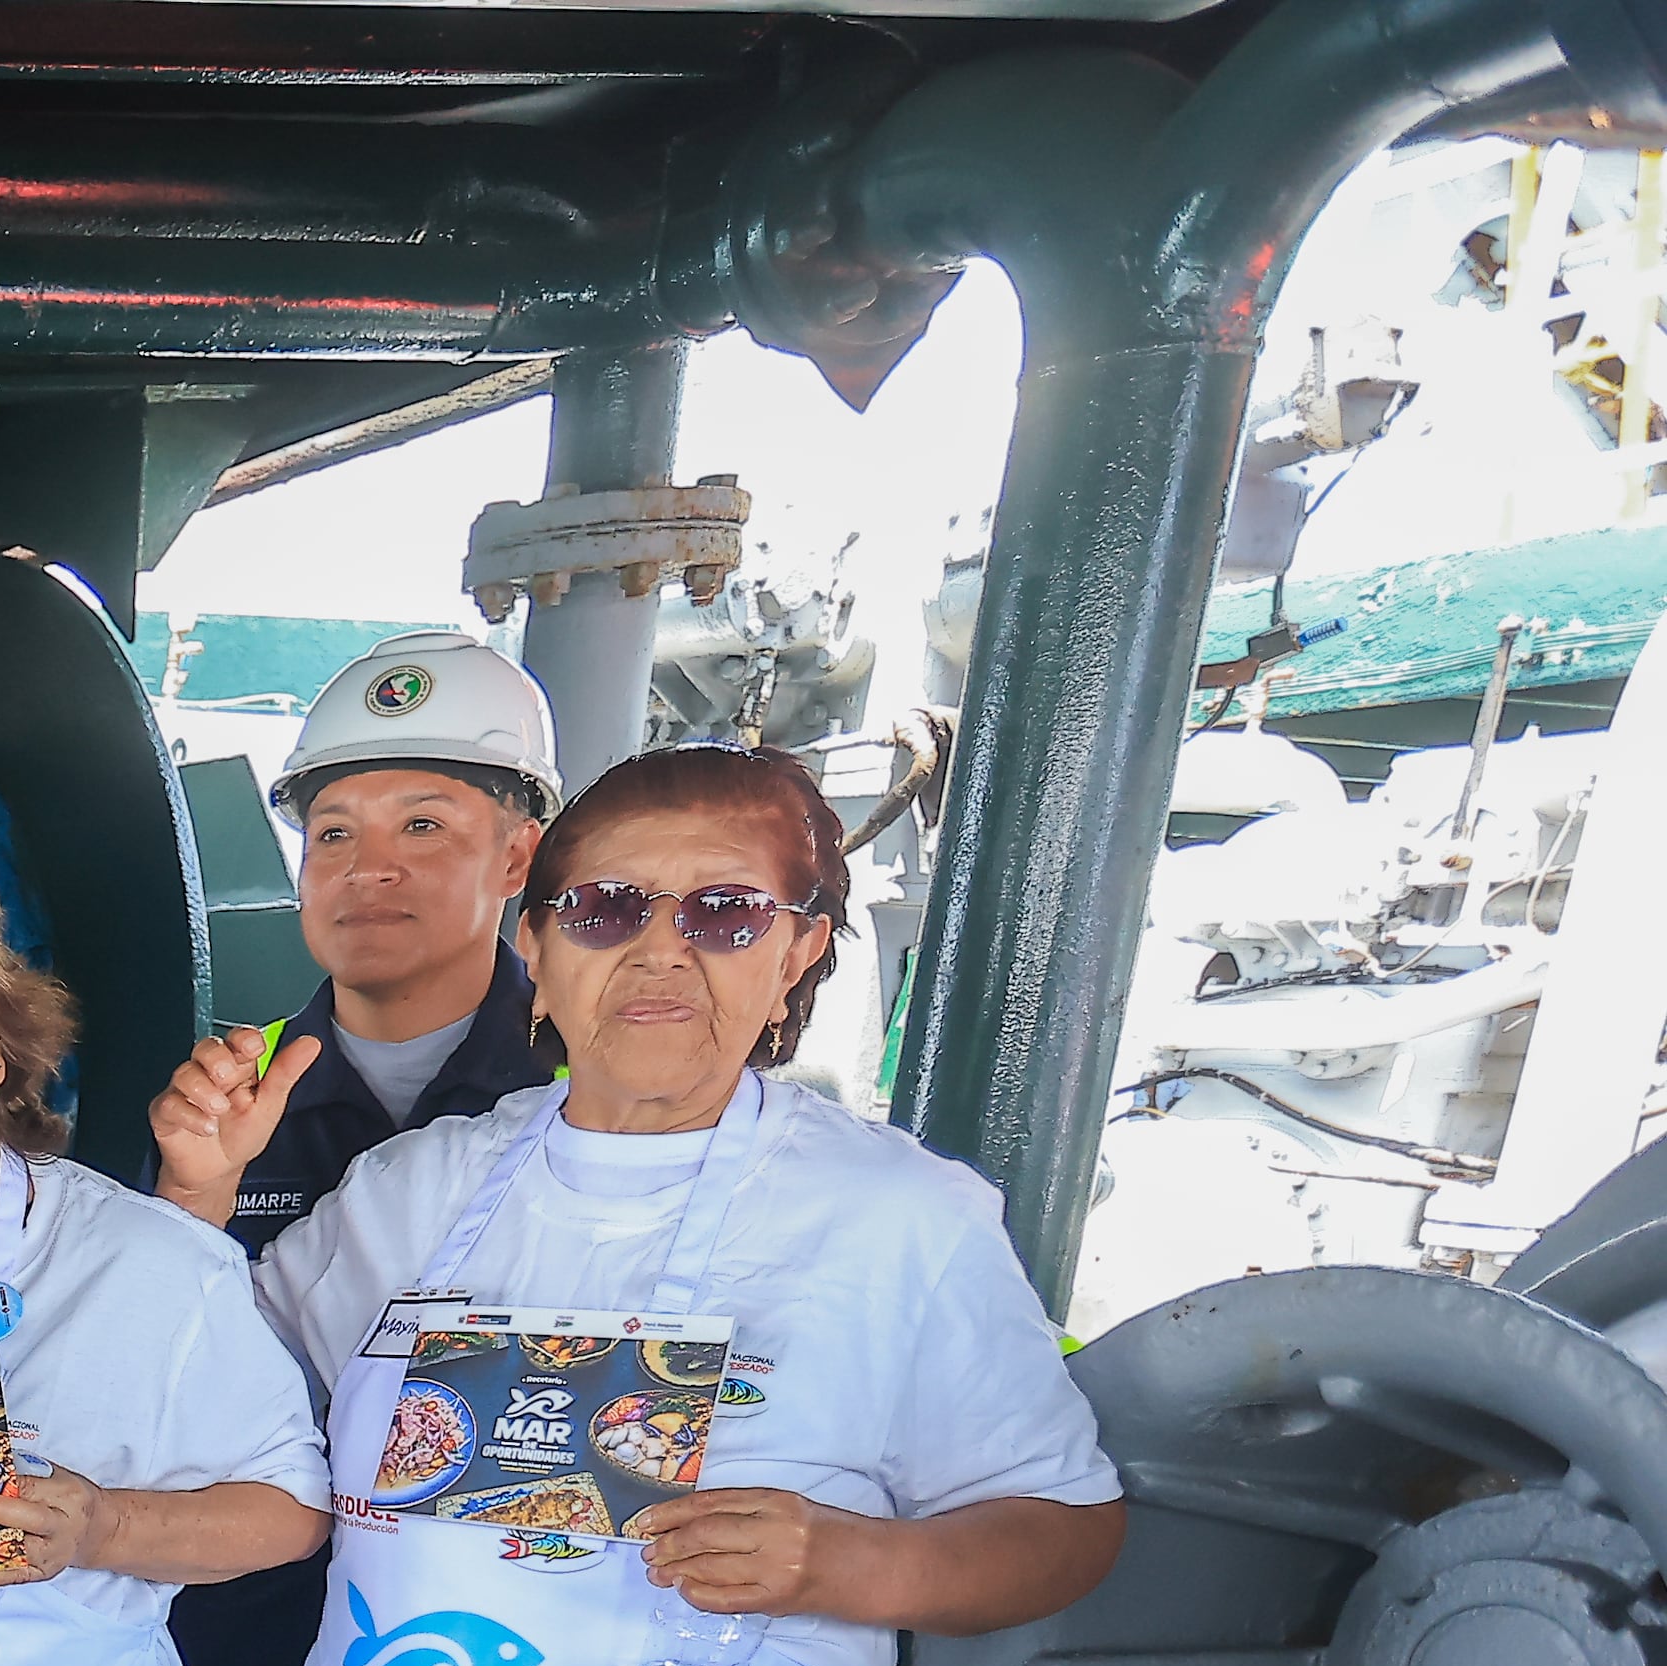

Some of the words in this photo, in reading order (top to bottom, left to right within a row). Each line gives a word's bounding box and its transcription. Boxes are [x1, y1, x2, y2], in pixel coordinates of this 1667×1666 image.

[237, 1192, 303, 1209] IMARPE
[493, 1417, 572, 1445] MAR
[482, 1444, 576, 1465] OPORTUNIDADES
